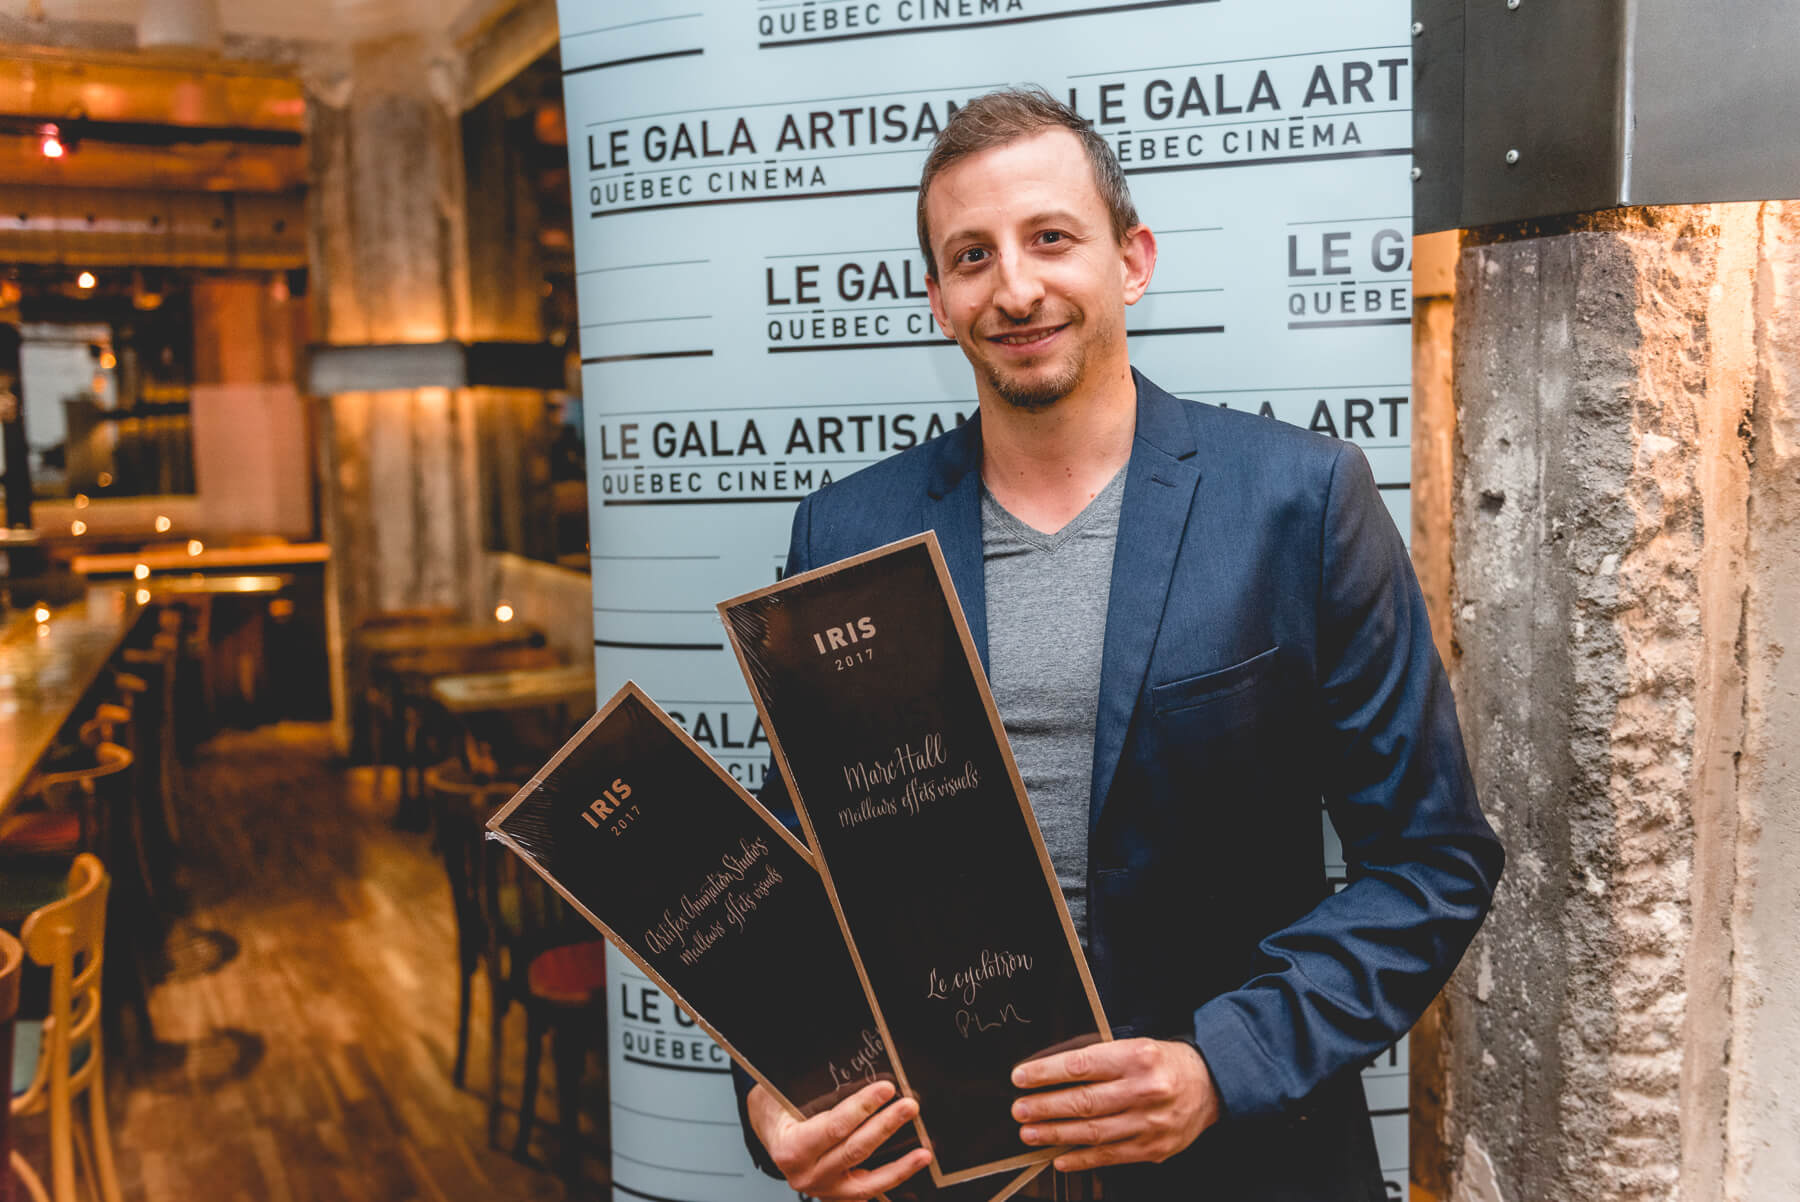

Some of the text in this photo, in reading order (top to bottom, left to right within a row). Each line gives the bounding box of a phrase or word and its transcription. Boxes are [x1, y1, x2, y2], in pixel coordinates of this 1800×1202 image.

[1069, 59, 1409, 125] LE GALA ART
[588, 129, 630, 171] LE
[644, 118, 756, 163] GALA
[1287, 228, 1412, 277] LE G
[766, 259, 928, 306] LE GAL
[600, 423, 640, 460] LE
[652, 419, 767, 459] GALA
[1308, 397, 1409, 439] ART
[813, 616, 877, 655] IRIS
[835, 648, 873, 672] 2017
[844, 732, 948, 792] Marc Hall
[937, 760, 981, 797] visuels
[581, 778, 632, 829] IRIS
[610, 805, 640, 836] 2017
[927, 949, 1033, 1006] Le cyclotron
[621, 983, 661, 1024] LE
